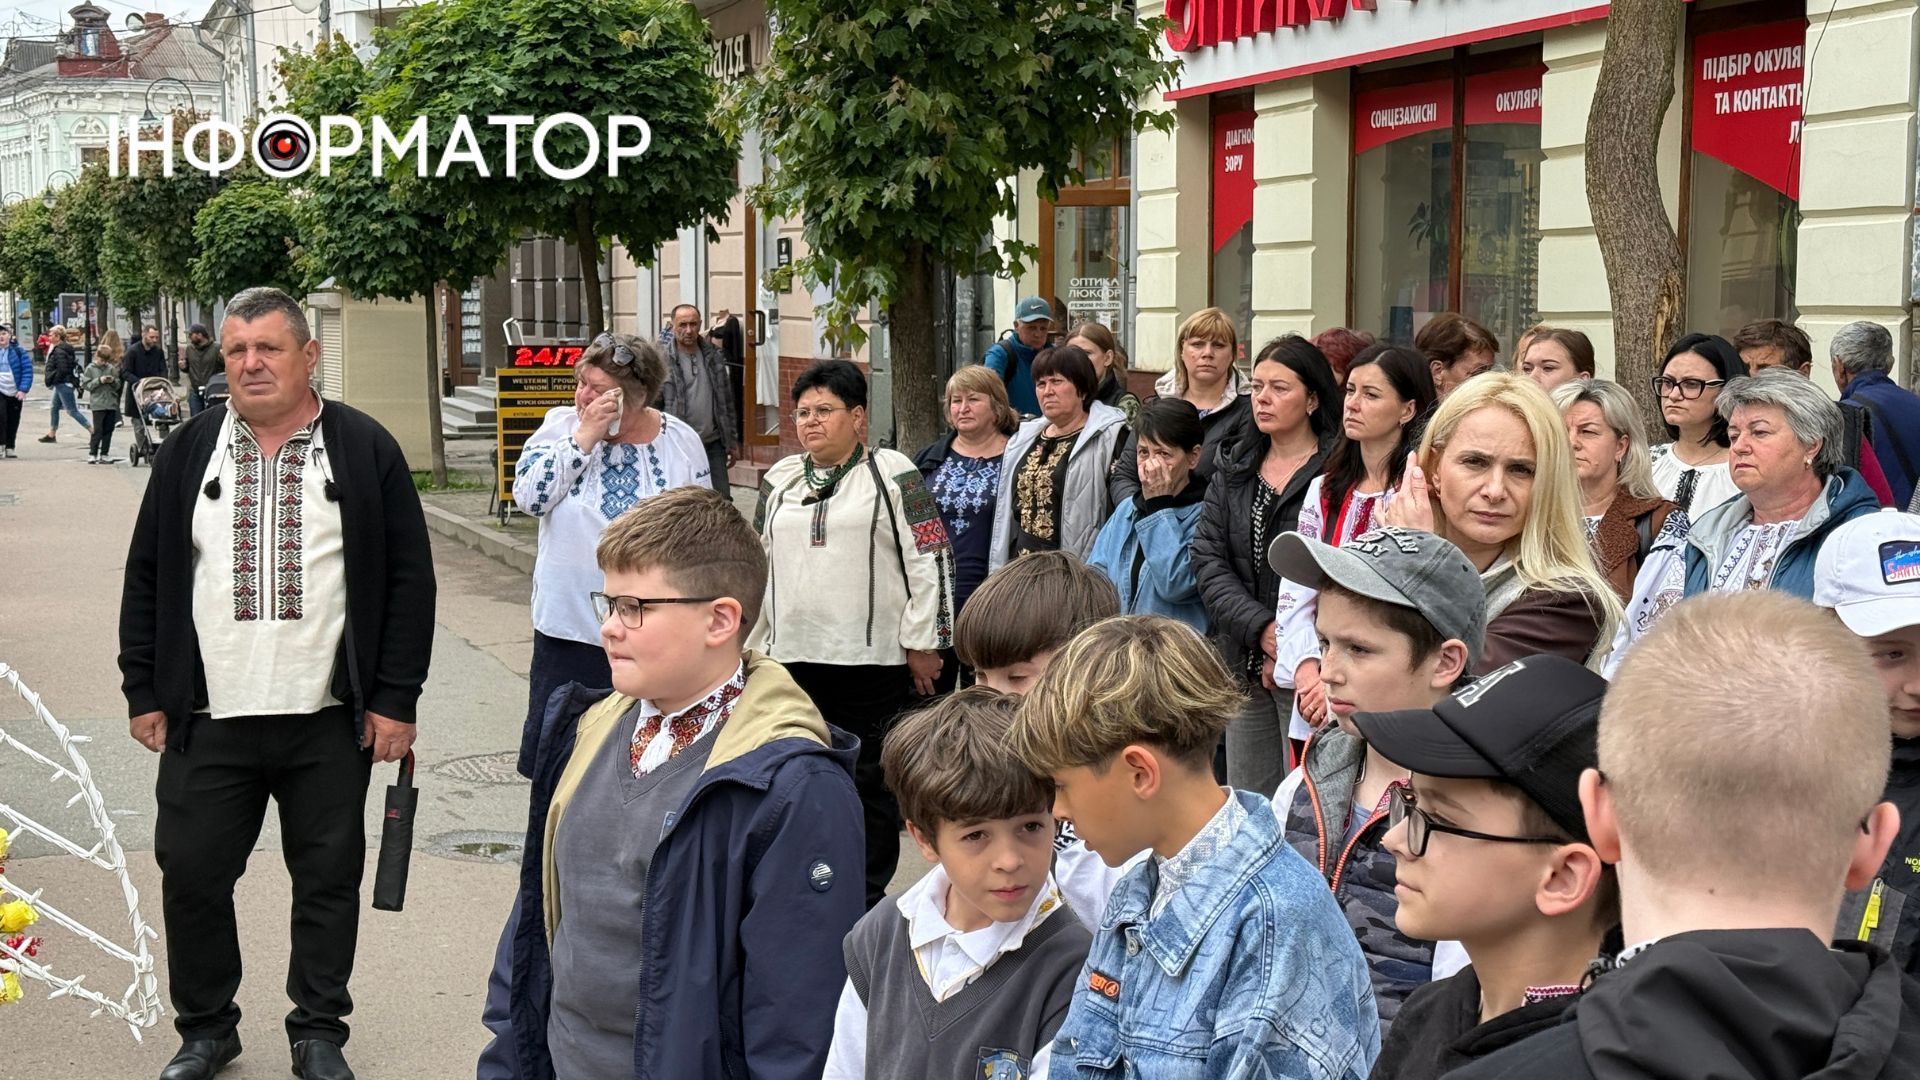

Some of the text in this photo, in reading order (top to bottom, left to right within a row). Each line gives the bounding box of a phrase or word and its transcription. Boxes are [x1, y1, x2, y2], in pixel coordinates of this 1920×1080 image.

[1703, 53, 1752, 84] ПІДБІР
[1714, 91, 1730, 115] ТА
[1370, 102, 1437, 130] СОНЦЕЗАХИСНІ
[1224, 154, 1244, 173] ЗОРУ
[1070, 277, 1120, 287] ОПТИКА
[515, 347, 583, 366] 24/7
